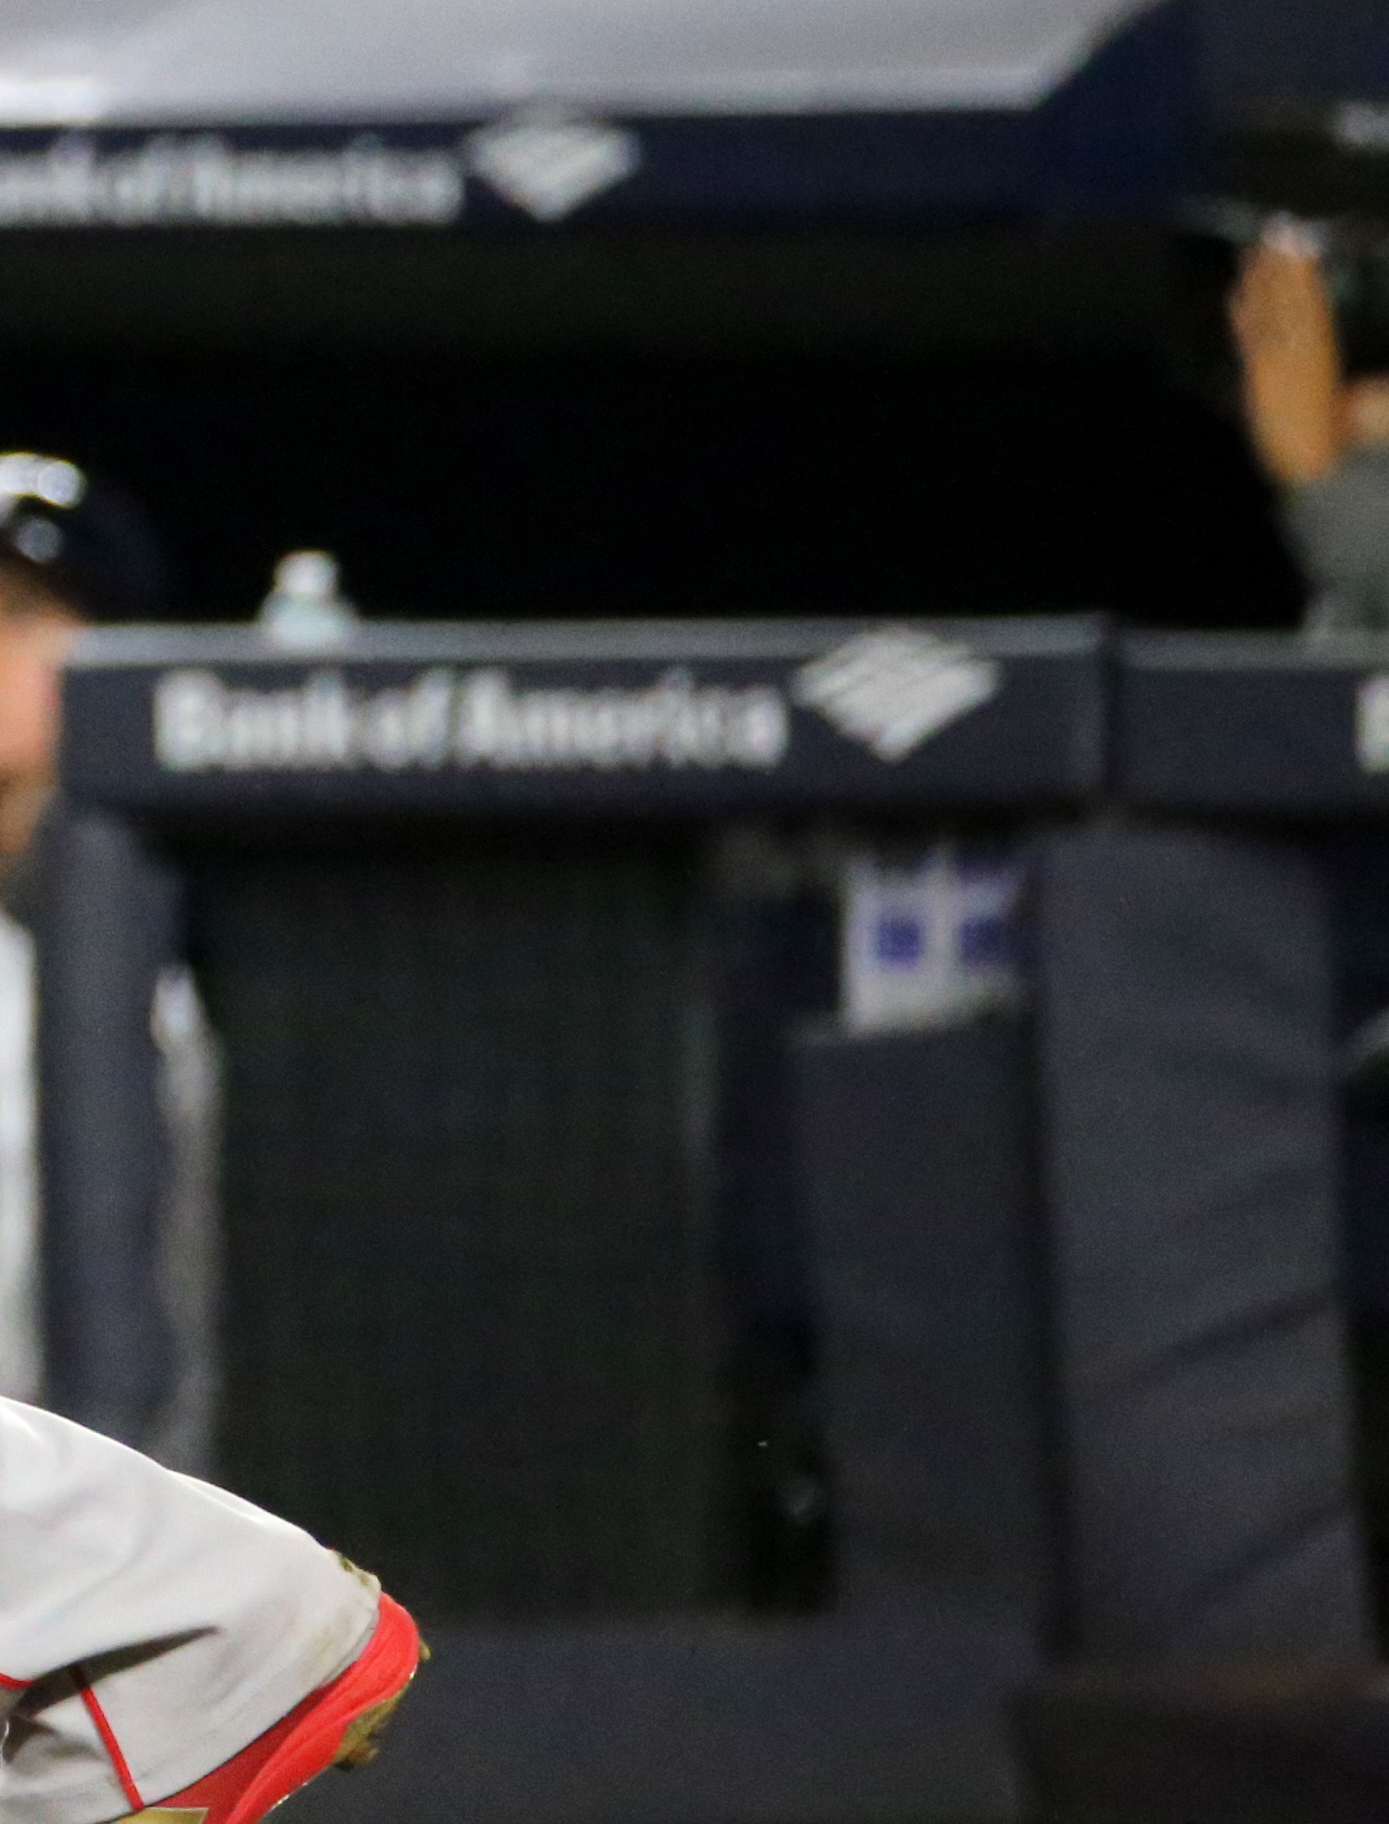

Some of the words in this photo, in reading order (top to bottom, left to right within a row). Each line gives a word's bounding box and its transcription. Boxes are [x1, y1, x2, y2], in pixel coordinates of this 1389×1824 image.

[102, 133, 184, 223] of
[180, 133, 463, 224] America
[154, 669, 348, 774] Bank
[356, 666, 454, 773] of
[450, 668, 787, 773] America
